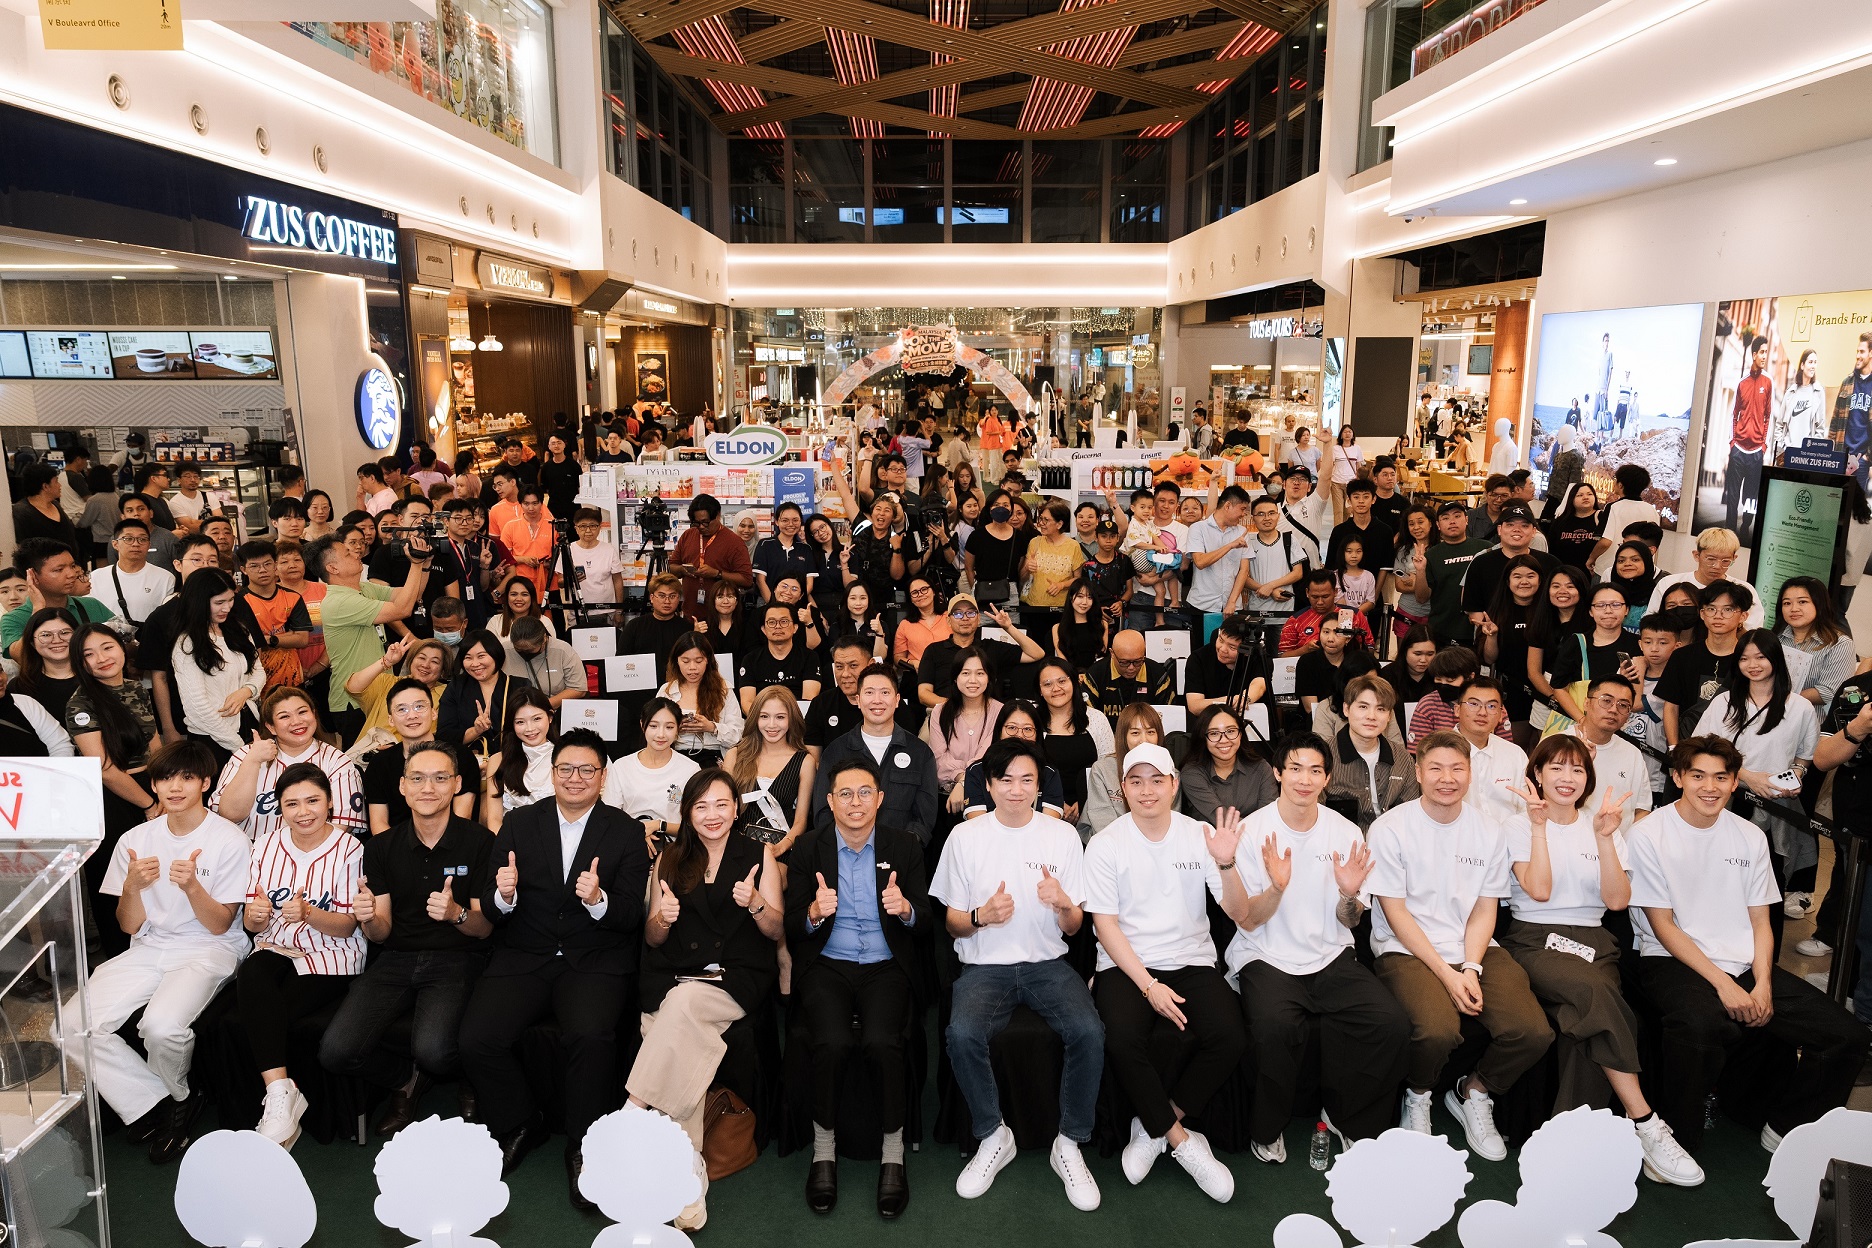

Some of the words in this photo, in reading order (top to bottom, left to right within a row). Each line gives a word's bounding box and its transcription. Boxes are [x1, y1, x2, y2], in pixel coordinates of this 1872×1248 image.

[55, 19, 96, 27] Bouleavrd
[97, 19, 120, 27] Office
[247, 195, 306, 247] ZUS
[308, 211, 397, 265] COFFEE
[1815, 313, 1848, 326] Brands
[1850, 312, 1868, 324] For
[910, 335, 928, 347] ON
[909, 341, 951, 357] MOVE
[1796, 400, 1810, 410] NIKE
[715, 440, 775, 455] ELDON
[1140, 451, 1162, 459] Ensure
[1790, 456, 1809, 466] DRINK
[1809, 458, 1822, 467] ZUS
[1822, 460, 1840, 469] FIRST
[1797, 495, 1810, 504] ECO
